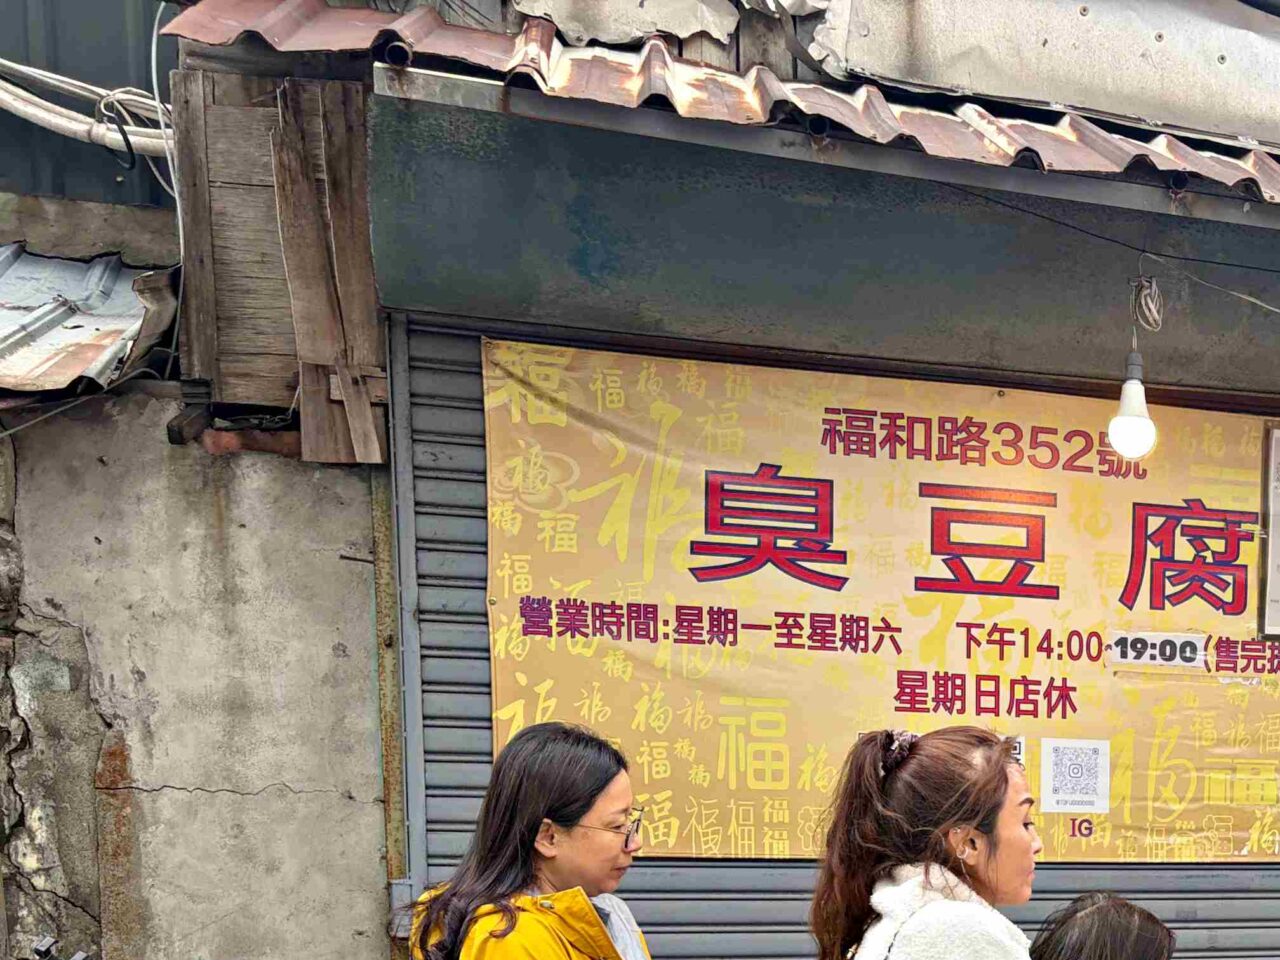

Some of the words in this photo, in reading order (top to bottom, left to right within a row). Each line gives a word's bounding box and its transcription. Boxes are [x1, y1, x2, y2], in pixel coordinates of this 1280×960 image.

[688, 463, 1260, 617] 臭豆腐
[519, 596, 903, 656] 營業時間:星期一至星期六
[893, 669, 1079, 720] 星期日店休
[1069, 818, 1094, 838] IG
